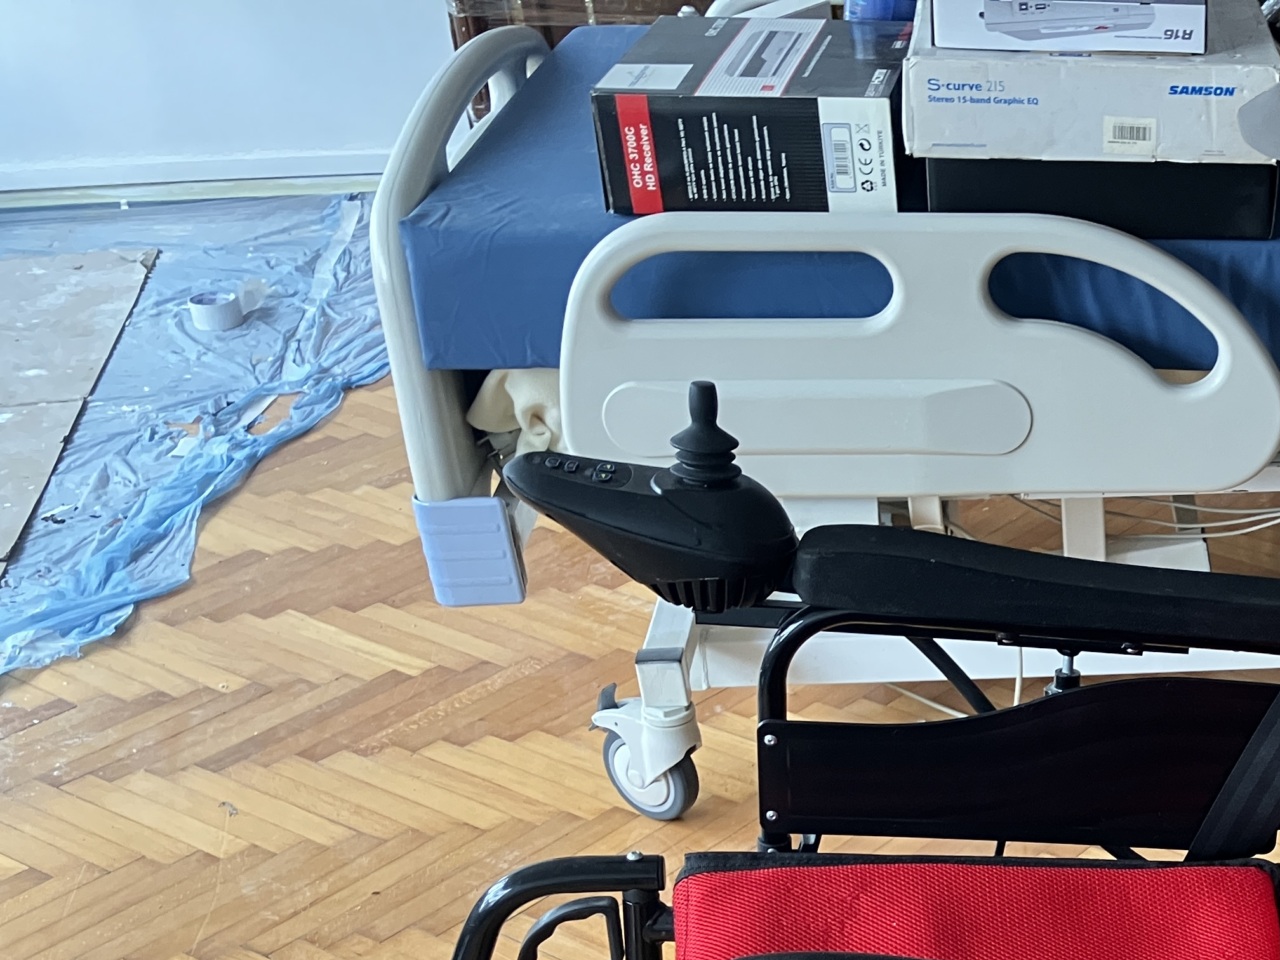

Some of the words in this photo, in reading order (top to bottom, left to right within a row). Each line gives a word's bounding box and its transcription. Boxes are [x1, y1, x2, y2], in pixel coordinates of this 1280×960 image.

[1163, 29, 1194, 40] R16
[986, 80, 1005, 92] 215
[1168, 85, 1237, 96] SAMSON
[928, 94, 955, 103] Stereo
[957, 96, 991, 104] 15-band
[993, 96, 1024, 106] Graphic
[1027, 97, 1039, 106] EQ
[624, 126, 639, 160] 3700C
[639, 123, 654, 172] Receiver
[630, 163, 643, 188] OHC
[645, 174, 657, 191] HD
